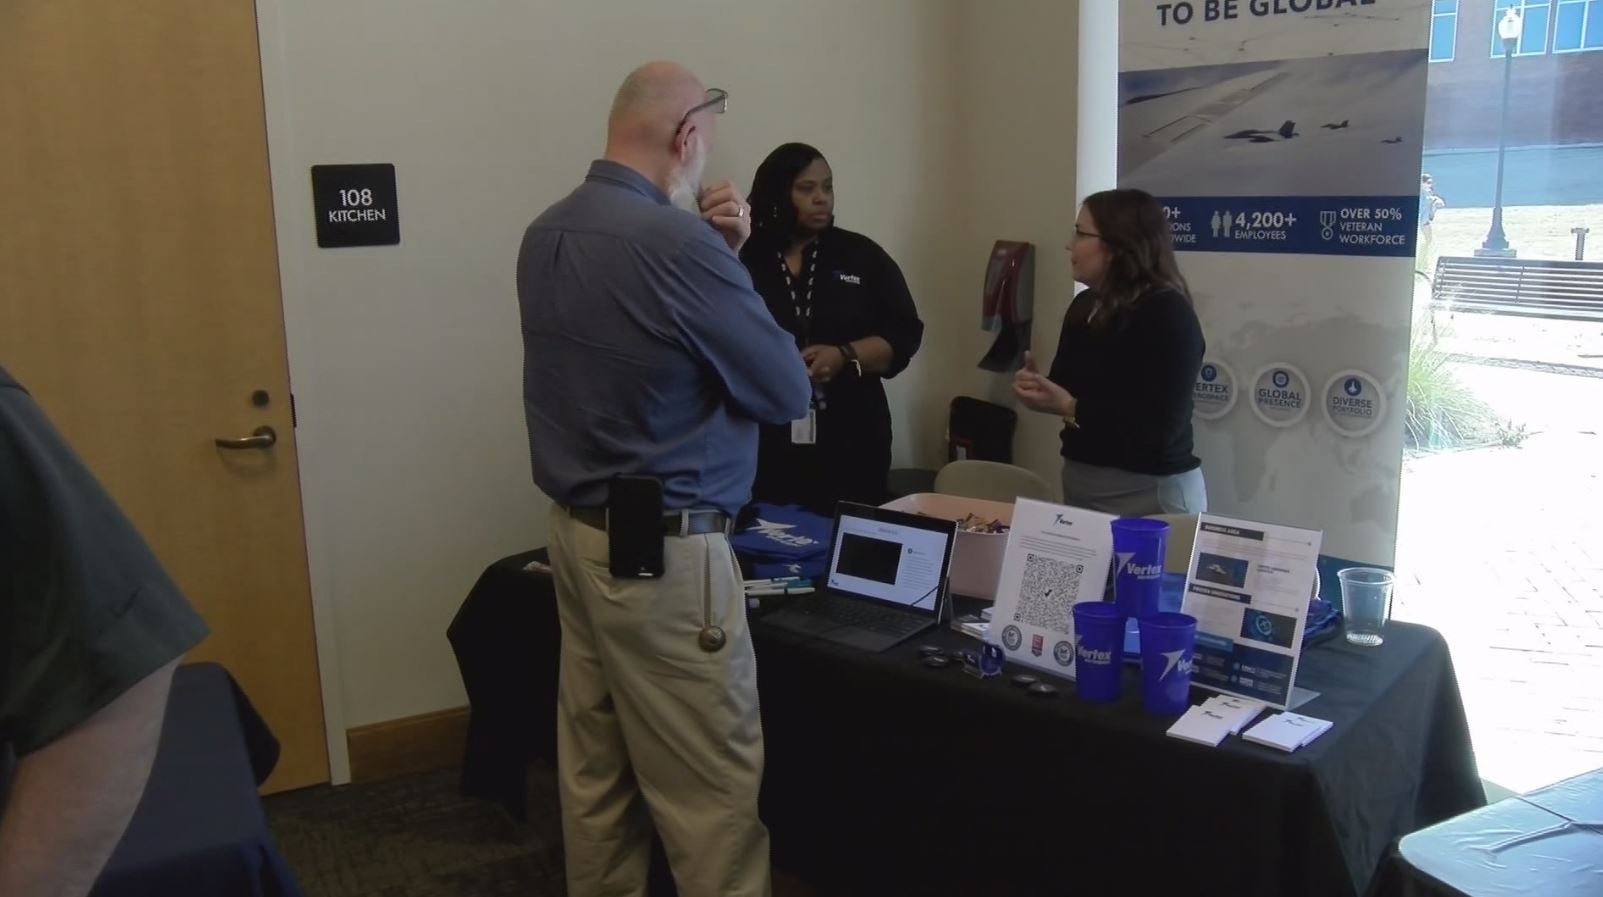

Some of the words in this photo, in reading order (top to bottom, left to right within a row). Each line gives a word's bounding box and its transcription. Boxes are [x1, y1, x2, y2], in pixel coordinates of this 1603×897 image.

[1156, 2, 1194, 26] TO
[1204, 0, 1239, 22] BE
[339, 188, 373, 206] 108
[328, 208, 386, 222] KITCHEN
[1235, 211, 1297, 230] 4,200+
[1340, 208, 1370, 220] OVER
[1375, 208, 1403, 221] 50%
[1340, 221, 1383, 232] VETERAN
[1234, 230, 1287, 241] EMPLOYEES
[1339, 234, 1406, 246] WORKFORCE
[1194, 382, 1229, 394] ERTEX
[1258, 387, 1303, 402] GLOBAL
[1257, 397, 1302, 409] PRESENCE
[1332, 395, 1374, 409] DIVERSE
[1332, 405, 1374, 417] PORTFOLIO
[1126, 562, 1163, 577] Vertex
